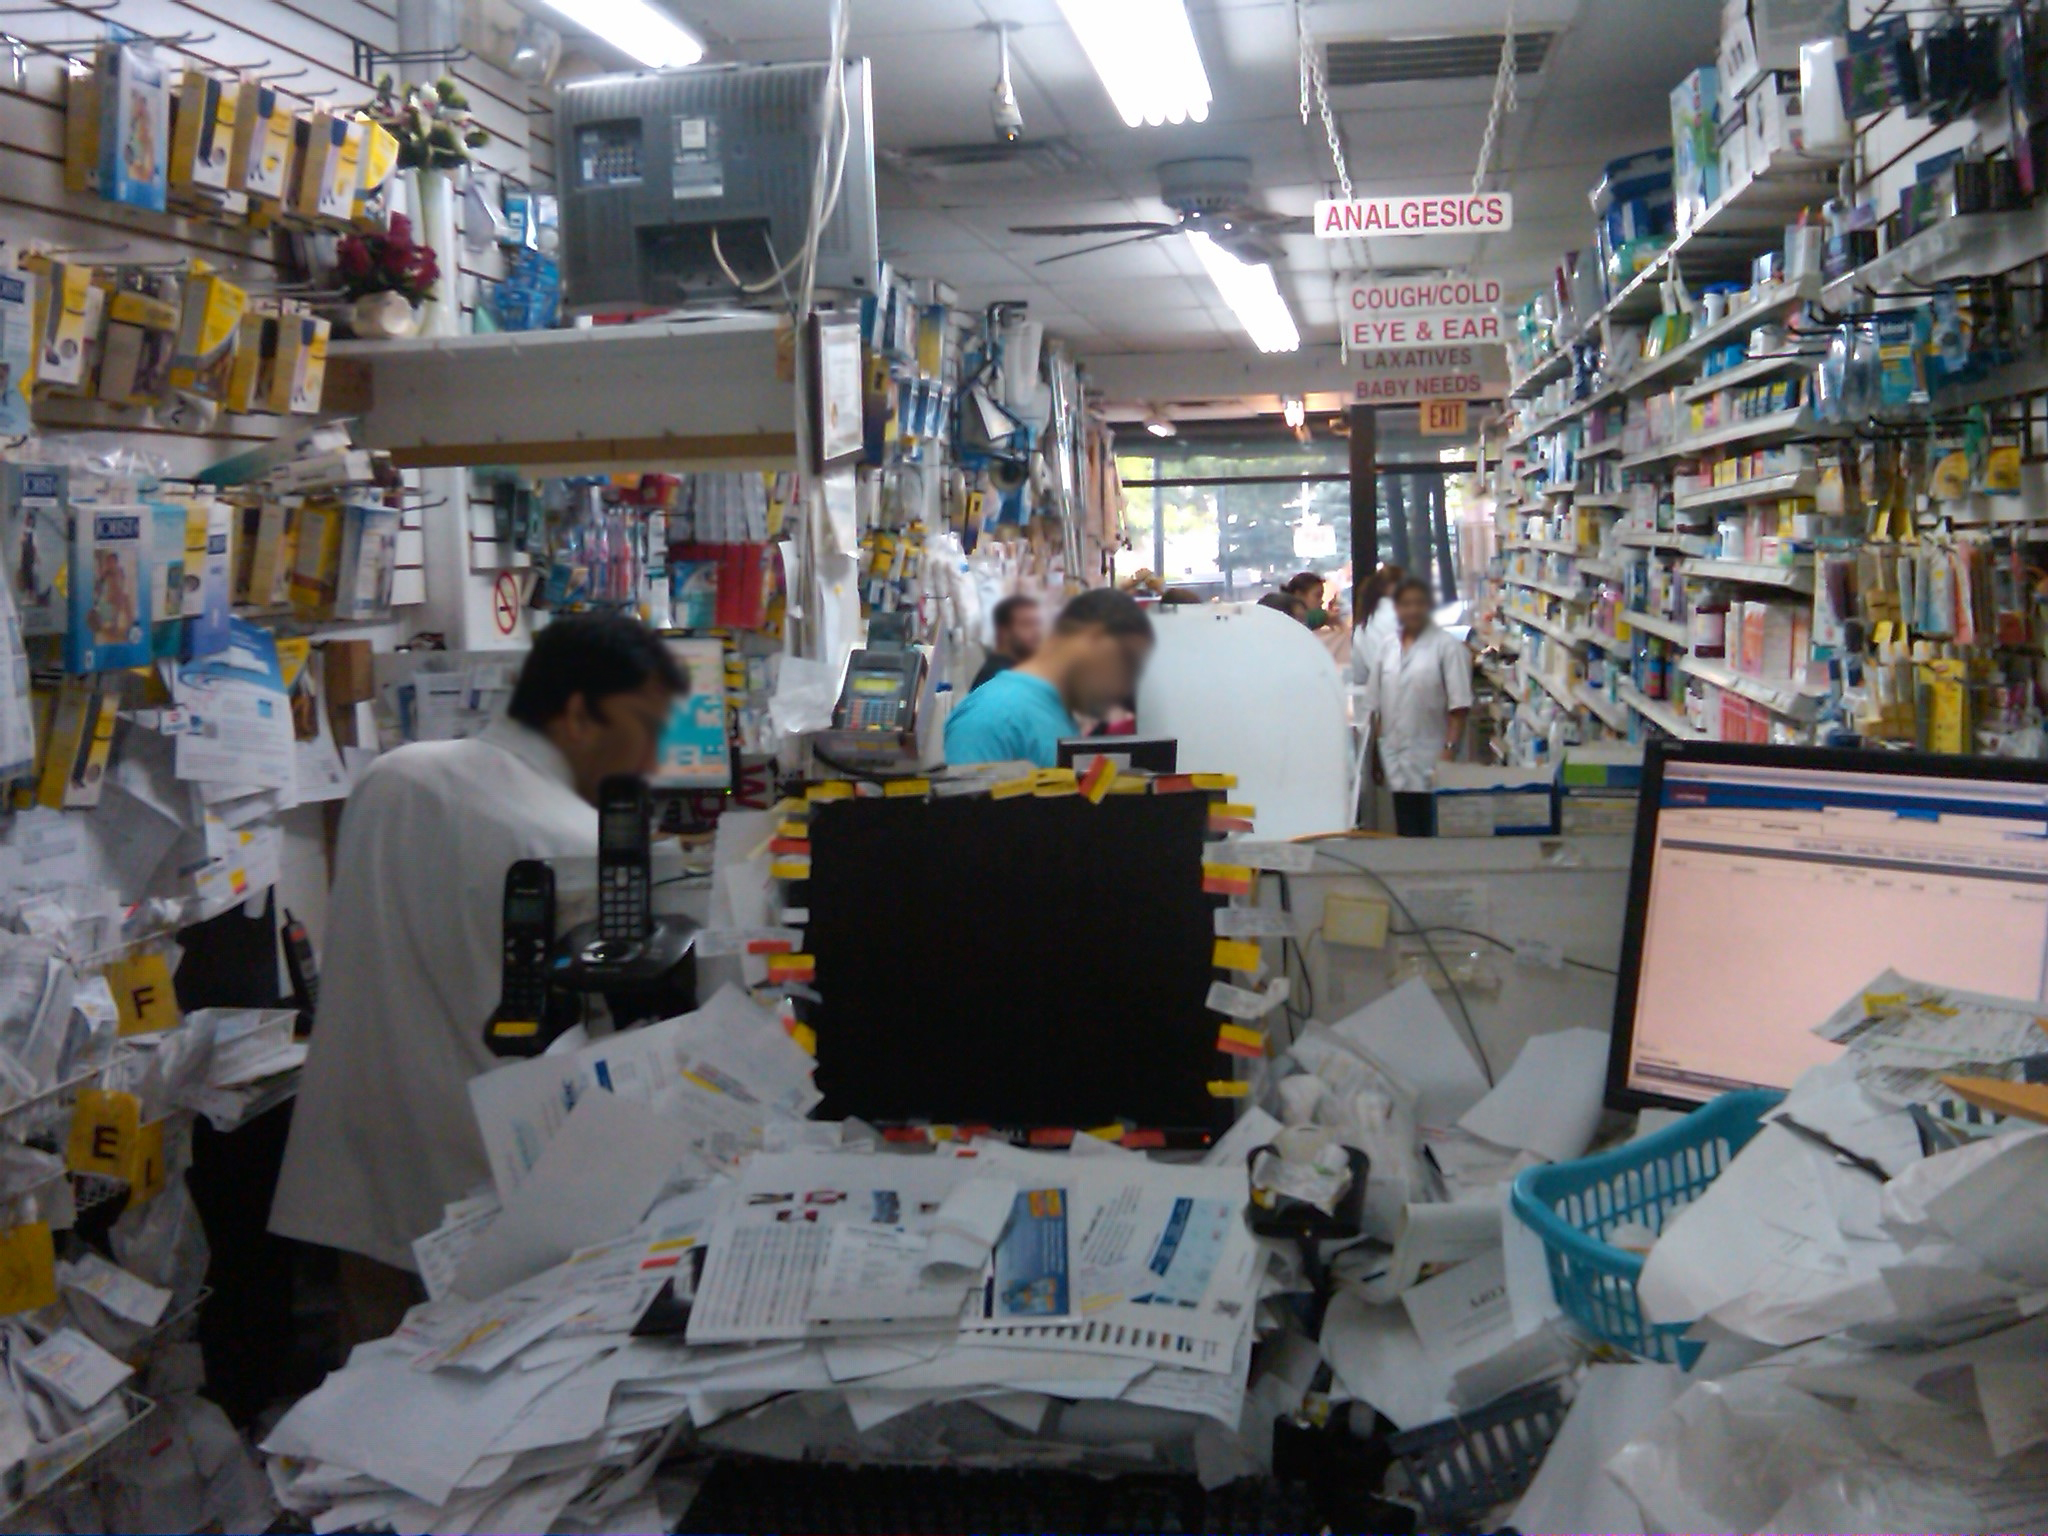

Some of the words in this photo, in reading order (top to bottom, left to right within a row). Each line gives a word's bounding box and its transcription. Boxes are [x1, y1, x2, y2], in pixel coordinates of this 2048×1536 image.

[1325, 198, 1504, 231] ANALGESICS
[1351, 282, 1500, 310] COUGH/COLD
[1354, 320, 1406, 343] EYE
[1416, 321, 1432, 341] &
[1443, 317, 1499, 340] EAR
[1362, 347, 1472, 370] LAXATIVES
[1355, 380, 1410, 399] BABY
[1415, 374, 1482, 396] NEEDS
[1430, 403, 1462, 429] EXIT
[131, 986, 155, 1019] F
[92, 1125, 119, 1159] E
